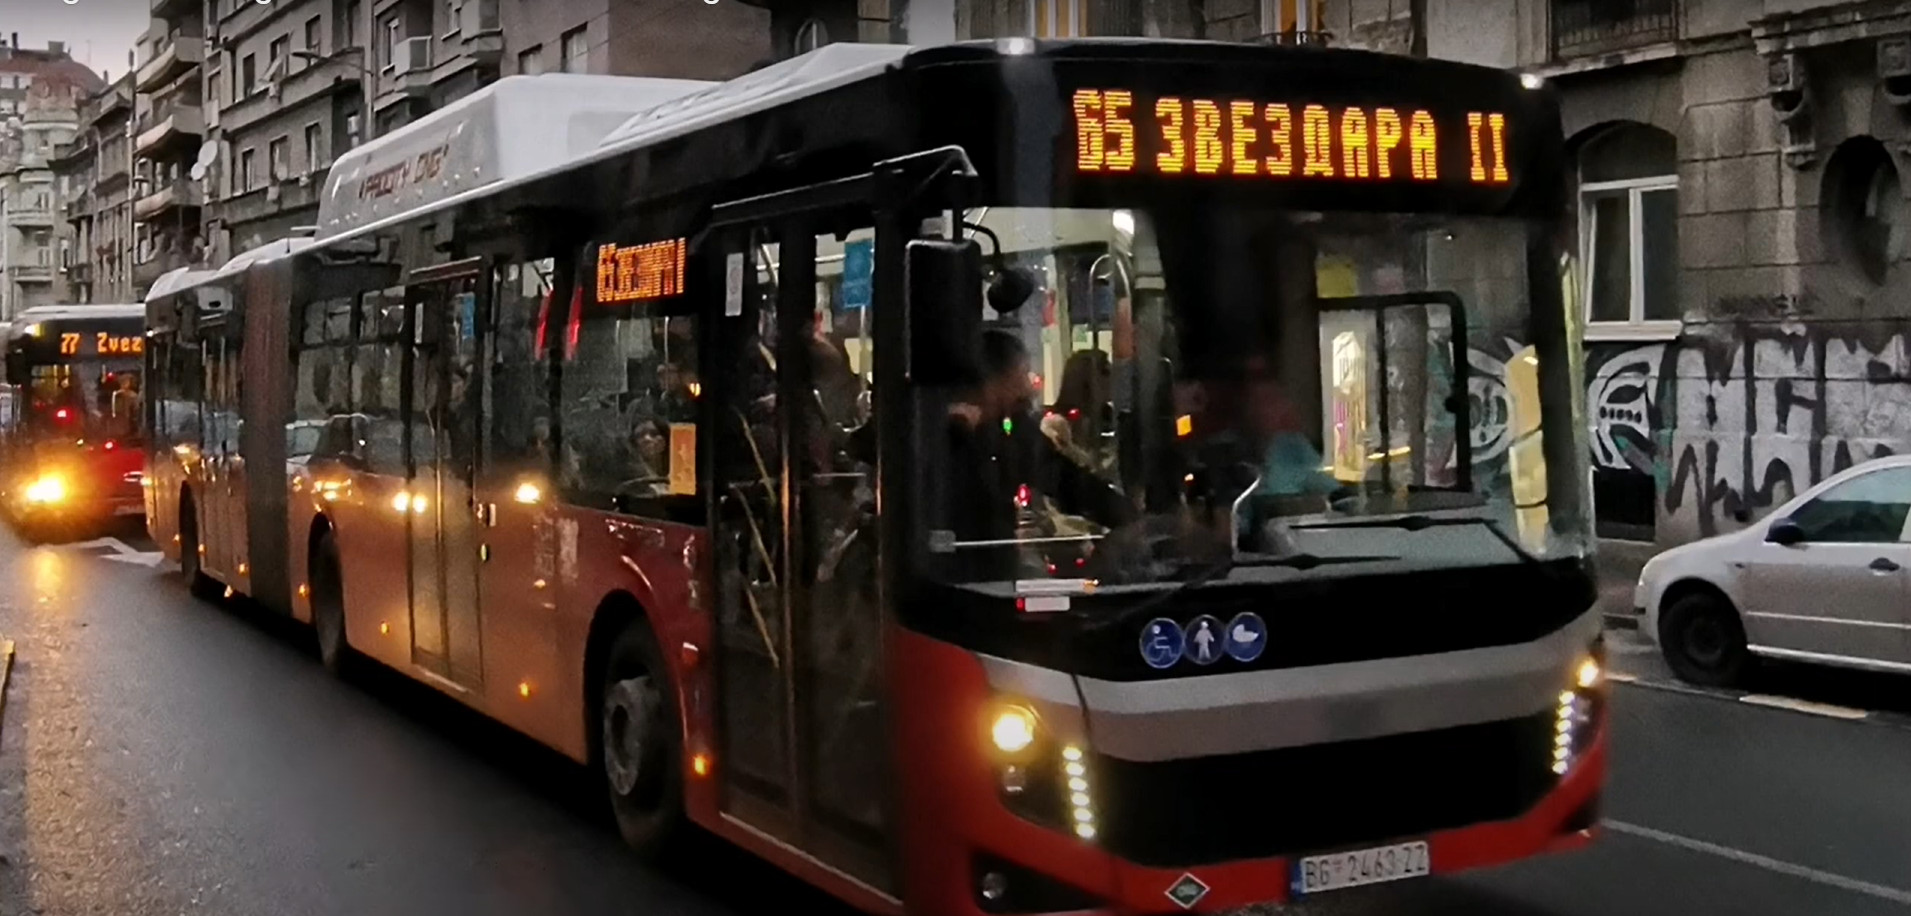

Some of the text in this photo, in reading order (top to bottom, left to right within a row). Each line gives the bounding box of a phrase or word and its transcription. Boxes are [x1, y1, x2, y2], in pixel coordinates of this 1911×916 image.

[1073, 89, 1135, 171] 65
[1155, 97, 1438, 180] ЗВЕЗДАРА
[596, 242, 617, 303] 65
[60, 332, 81, 354] 77
